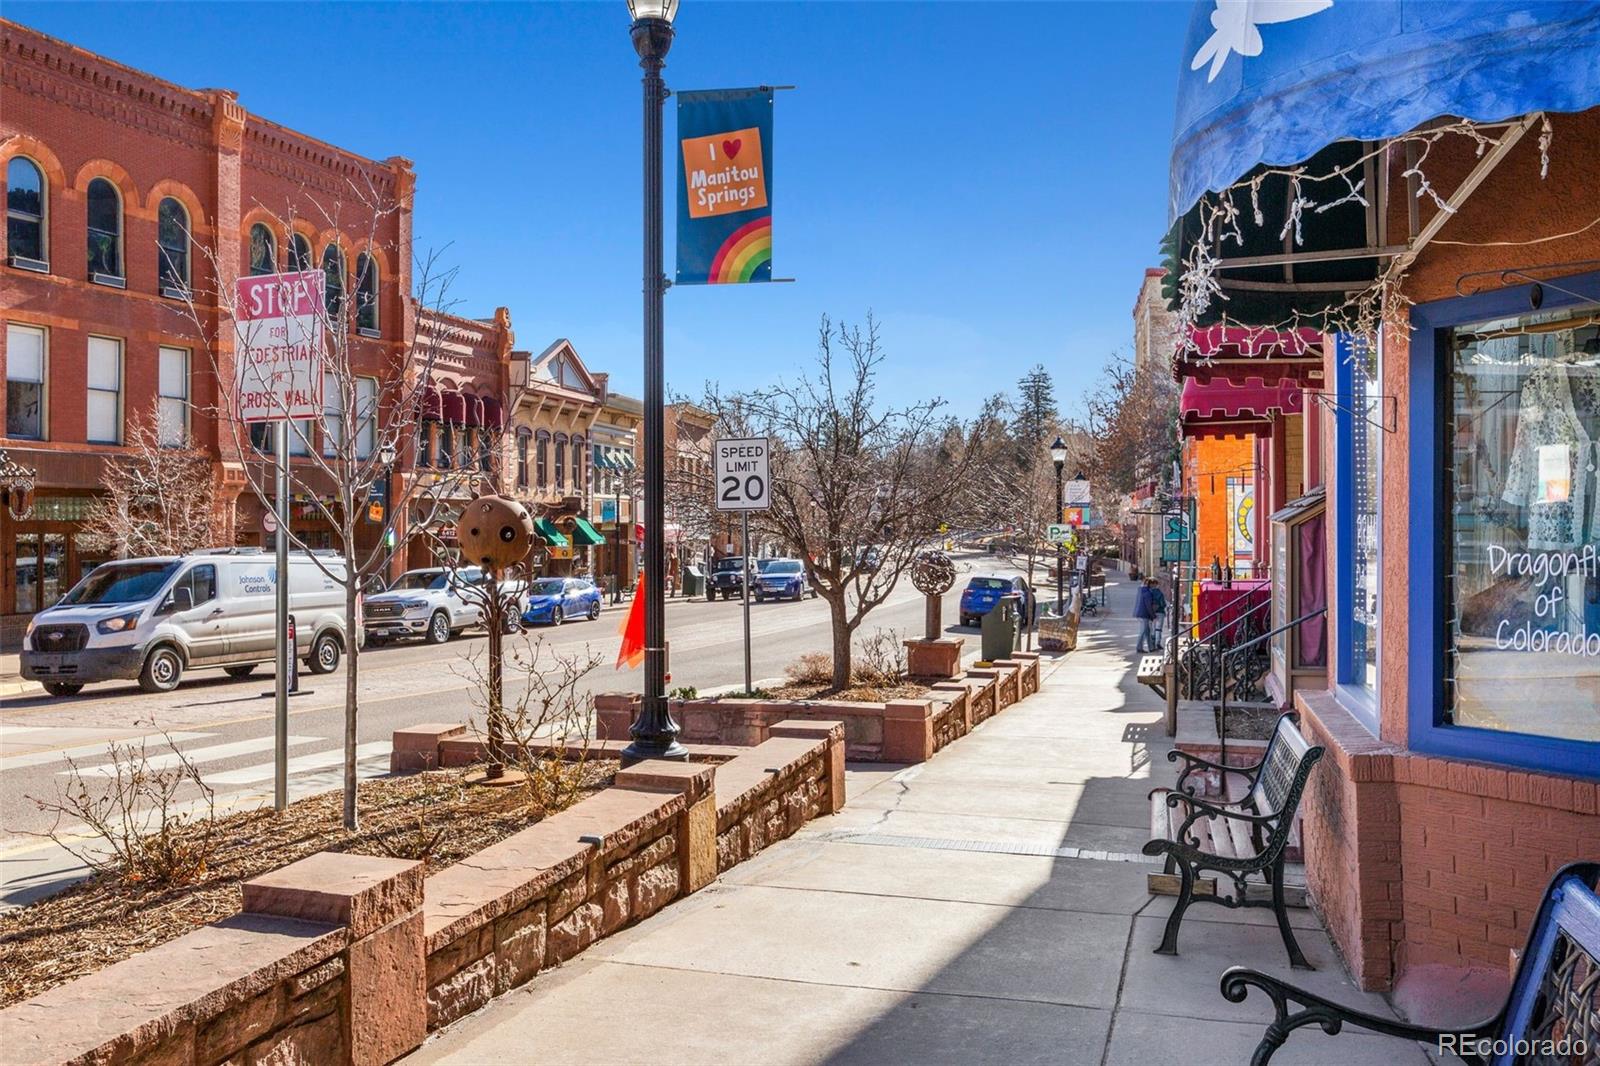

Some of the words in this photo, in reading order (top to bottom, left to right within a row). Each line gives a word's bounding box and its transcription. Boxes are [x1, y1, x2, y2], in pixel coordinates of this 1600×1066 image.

[709, 143, 716, 161] I
[690, 166, 759, 189] Manitou
[697, 185, 756, 211] Springs
[250, 279, 308, 316] STOP
[269, 327, 287, 338] FOR
[240, 391, 278, 409] CROSS
[721, 446, 764, 458] SPEED
[726, 460, 759, 472] LIMIT
[721, 474, 764, 501] 20
[1486, 543, 1600, 587] Dragonfl
[239, 575, 265, 585] Johnson
[244, 584, 271, 593] Controls
[1534, 585, 1563, 618] of
[1496, 618, 1600, 657] Colorado
